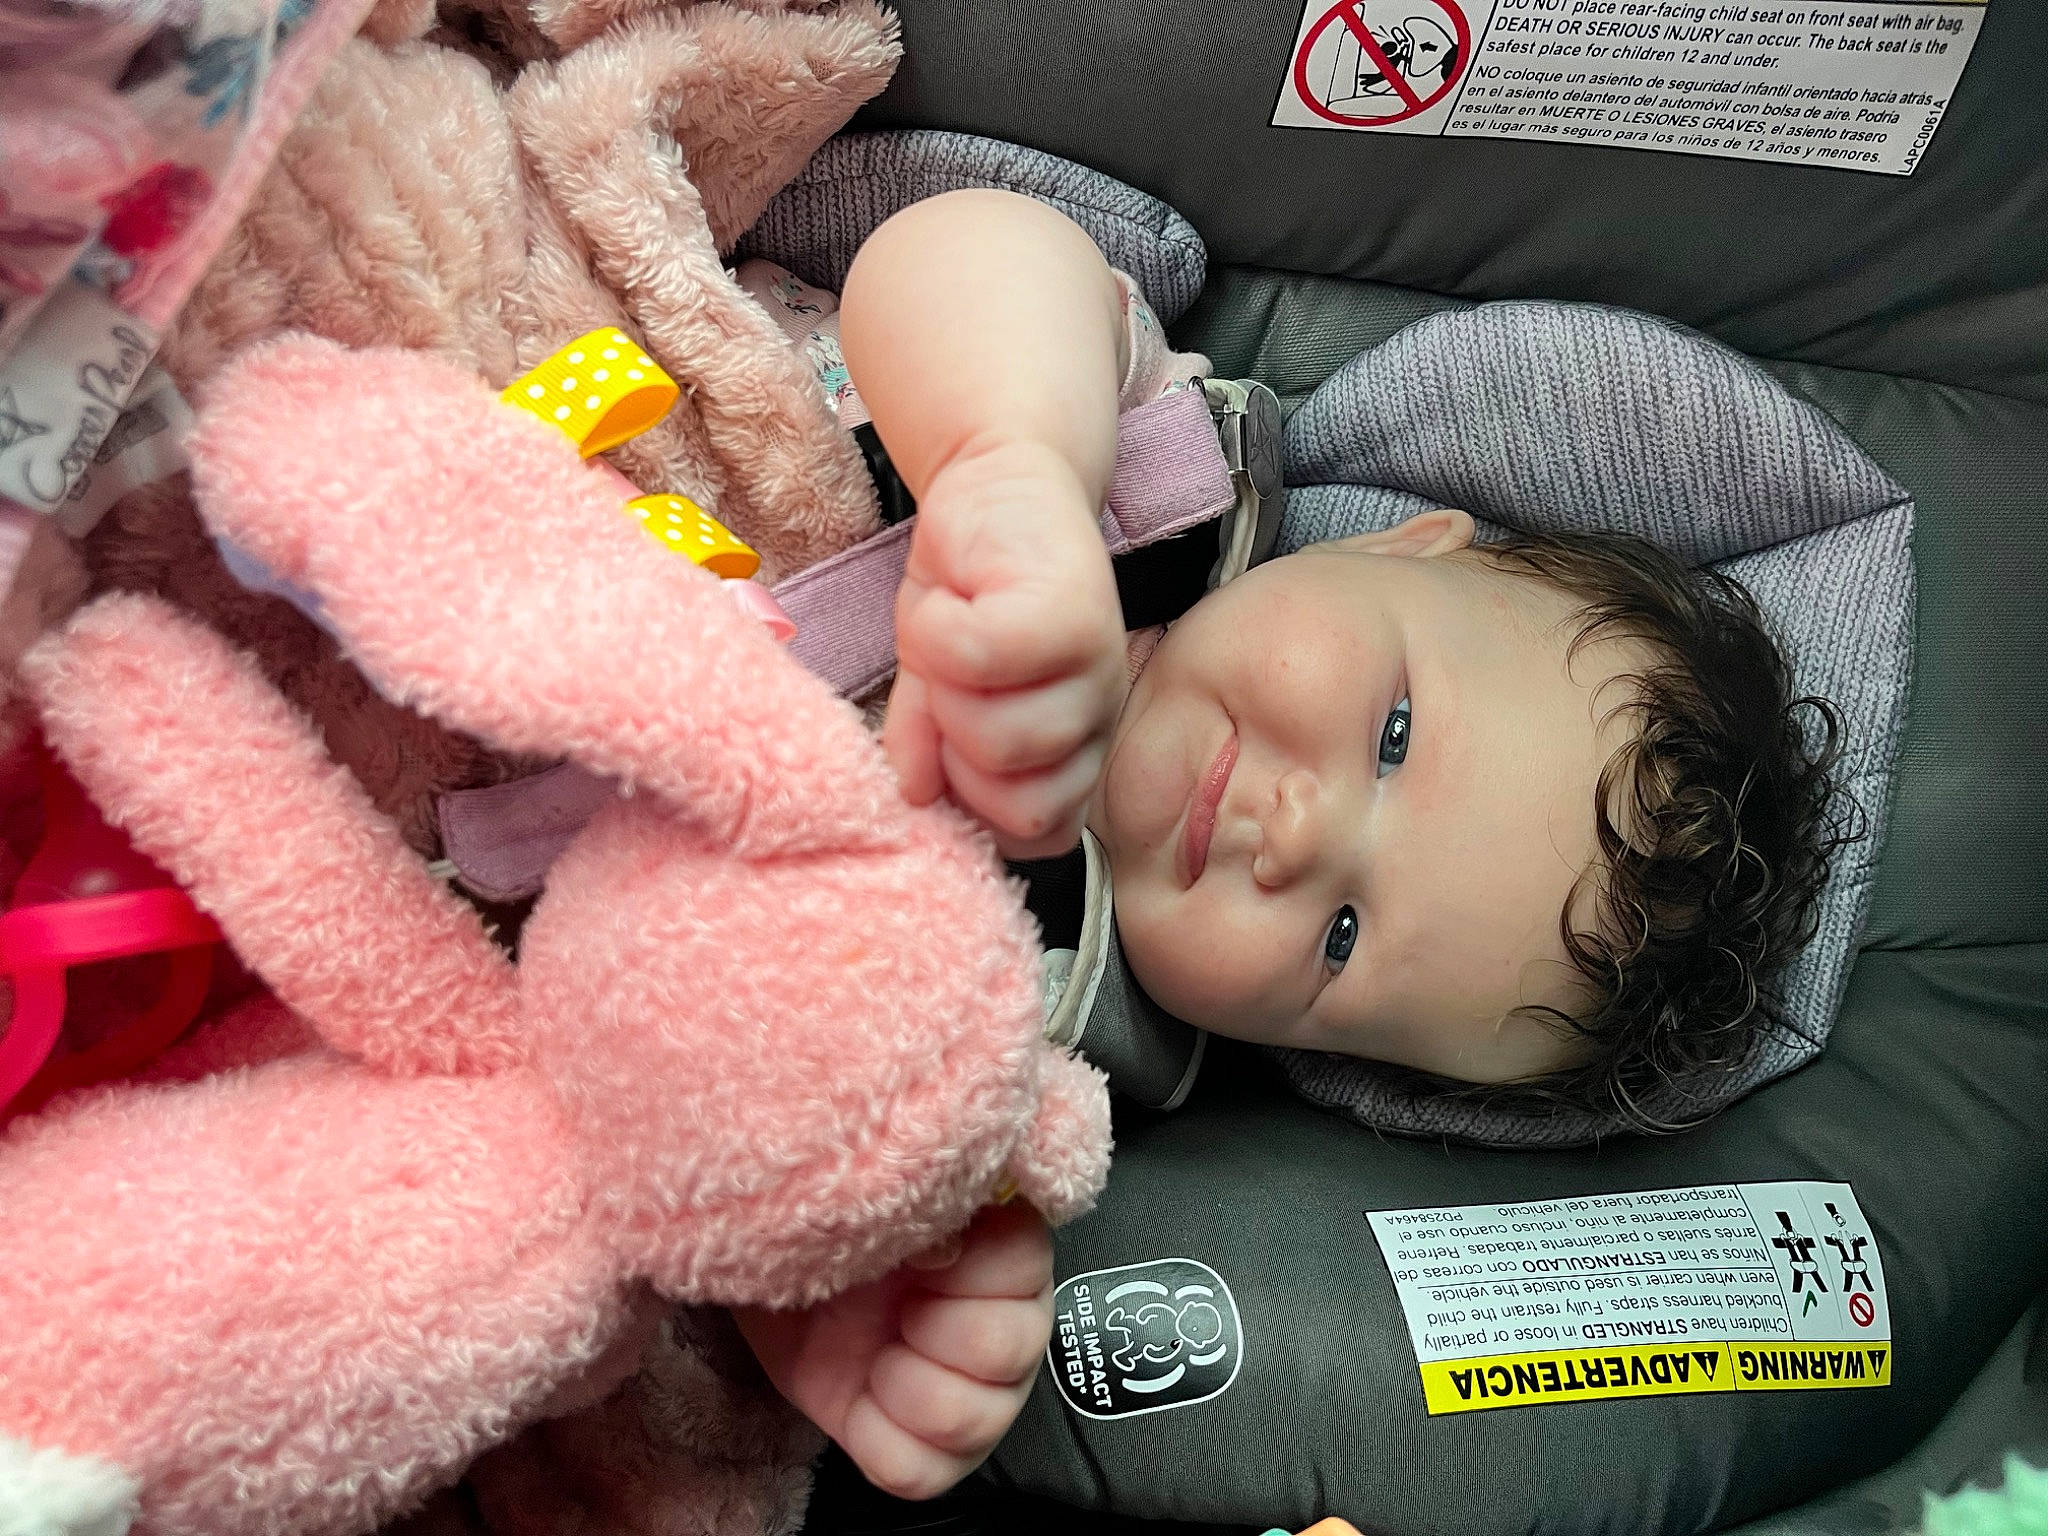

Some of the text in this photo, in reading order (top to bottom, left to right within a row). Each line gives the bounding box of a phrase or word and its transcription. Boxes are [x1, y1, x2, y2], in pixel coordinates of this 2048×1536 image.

[1495, 16, 1947, 54] DEATH OR SERIOUS INJURY can occur. The back seat is the
[1503, 0, 1965, 35] DO NOT place rear-facing child seat on front seat with air bag.
[1487, 40, 1779, 68] safest place for children 12 and under.
[1476, 66, 1932, 106] NO coloque un asiento de seguridad infantil orientado hacia atrás
[1459, 103, 1887, 143] resultar en MUERTE O LESIONES GRAVES, el asiento trasero
[1468, 86, 1900, 124] en el asiento delantero del automóvil con bolsa de aire. Podría
[1452, 119, 1880, 163] es el lugar más seguro para los niños de 12 años y menores.
[1384, 1212, 1463, 1224] PD258464A
[1493, 1188, 1736, 1219] transportador fuera del vehículo.
[1399, 1205, 1746, 1242] completamente al niño, incluso cuando use el
[1398, 1227, 1756, 1261] arnés sueltas o parcialmente trabadas. Refrene
[1394, 1247, 1766, 1284] Niños se han ESTRANGULADO con correas del
[1427, 1271, 1774, 1302] even when carrier is used outside the vehicle.
[1427, 1294, 1781, 1327] buckled harness straps. Fully restrain the child
[1074, 1285, 1112, 1407] SIDE IMPACT
[1423, 1317, 1788, 1351] Children have STRANGLED in loose or partially
[1449, 1353, 1690, 1400] ADVERTENCIA
[1737, 1351, 1865, 1381] WARNING
